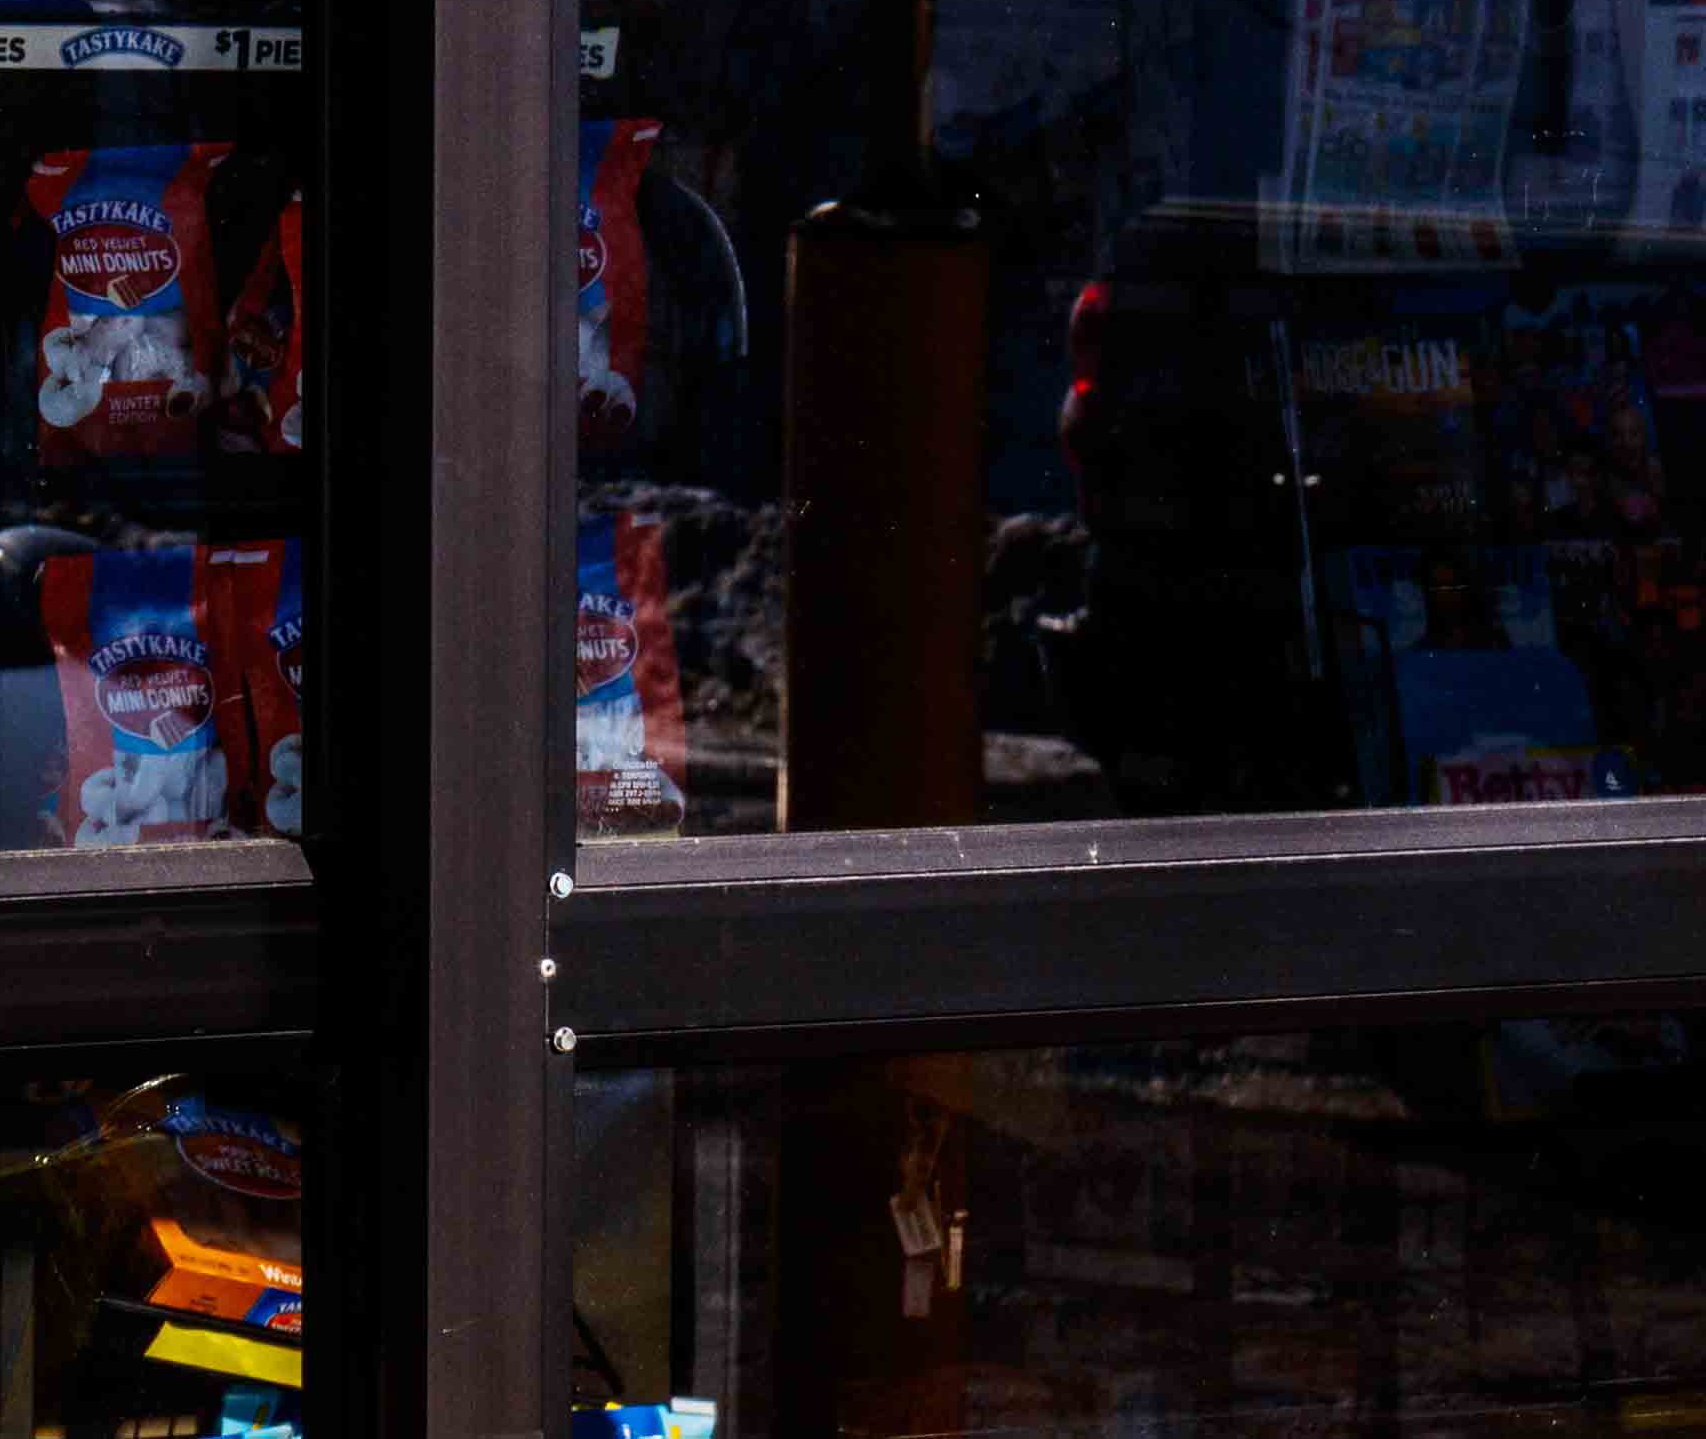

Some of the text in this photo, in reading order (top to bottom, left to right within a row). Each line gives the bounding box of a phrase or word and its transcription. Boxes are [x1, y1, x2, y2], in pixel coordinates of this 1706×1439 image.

[64, 29, 180, 65] TASTYKAKE
[215, 29, 301, 69] $1 PIE
[52, 200, 173, 235] TASTYKAKE
[60, 249, 174, 274] MINI DONUTS
[108, 397, 162, 412] WINTER
[90, 634, 206, 672] TASTYKAKE
[576, 638, 631, 662] NUTS
[107, 684, 210, 714] MINI DONUTS
